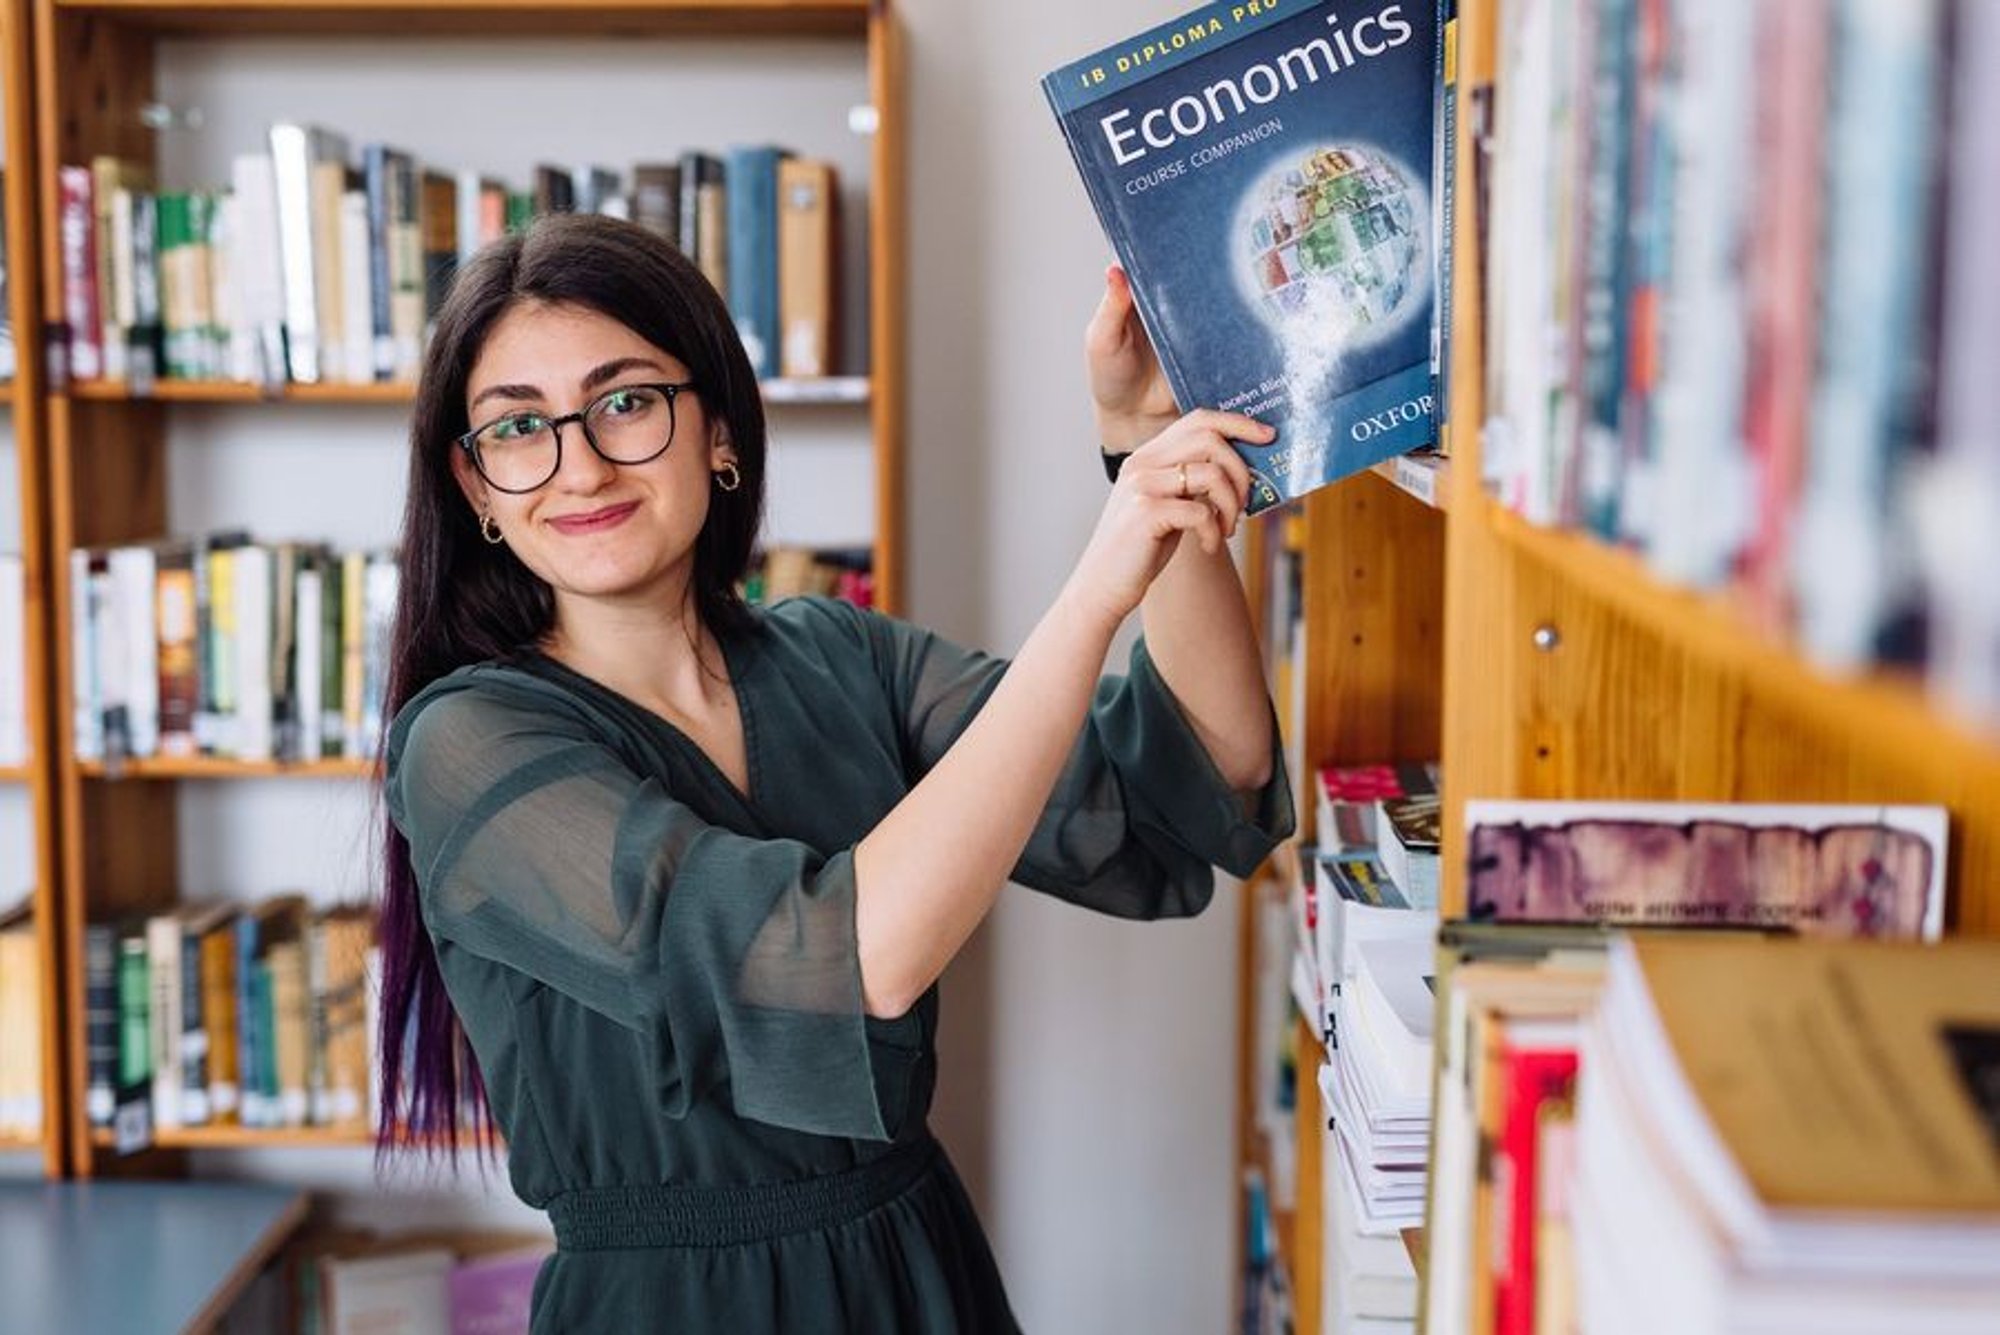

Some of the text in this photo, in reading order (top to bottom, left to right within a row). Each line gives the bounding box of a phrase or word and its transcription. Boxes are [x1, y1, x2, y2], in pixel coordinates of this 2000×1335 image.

[1081, 0, 1277, 88] IB DIPLOMA PRO
[1101, 4, 1412, 166] Economics
[1125, 117, 1283, 195] COURSE COMPANION
